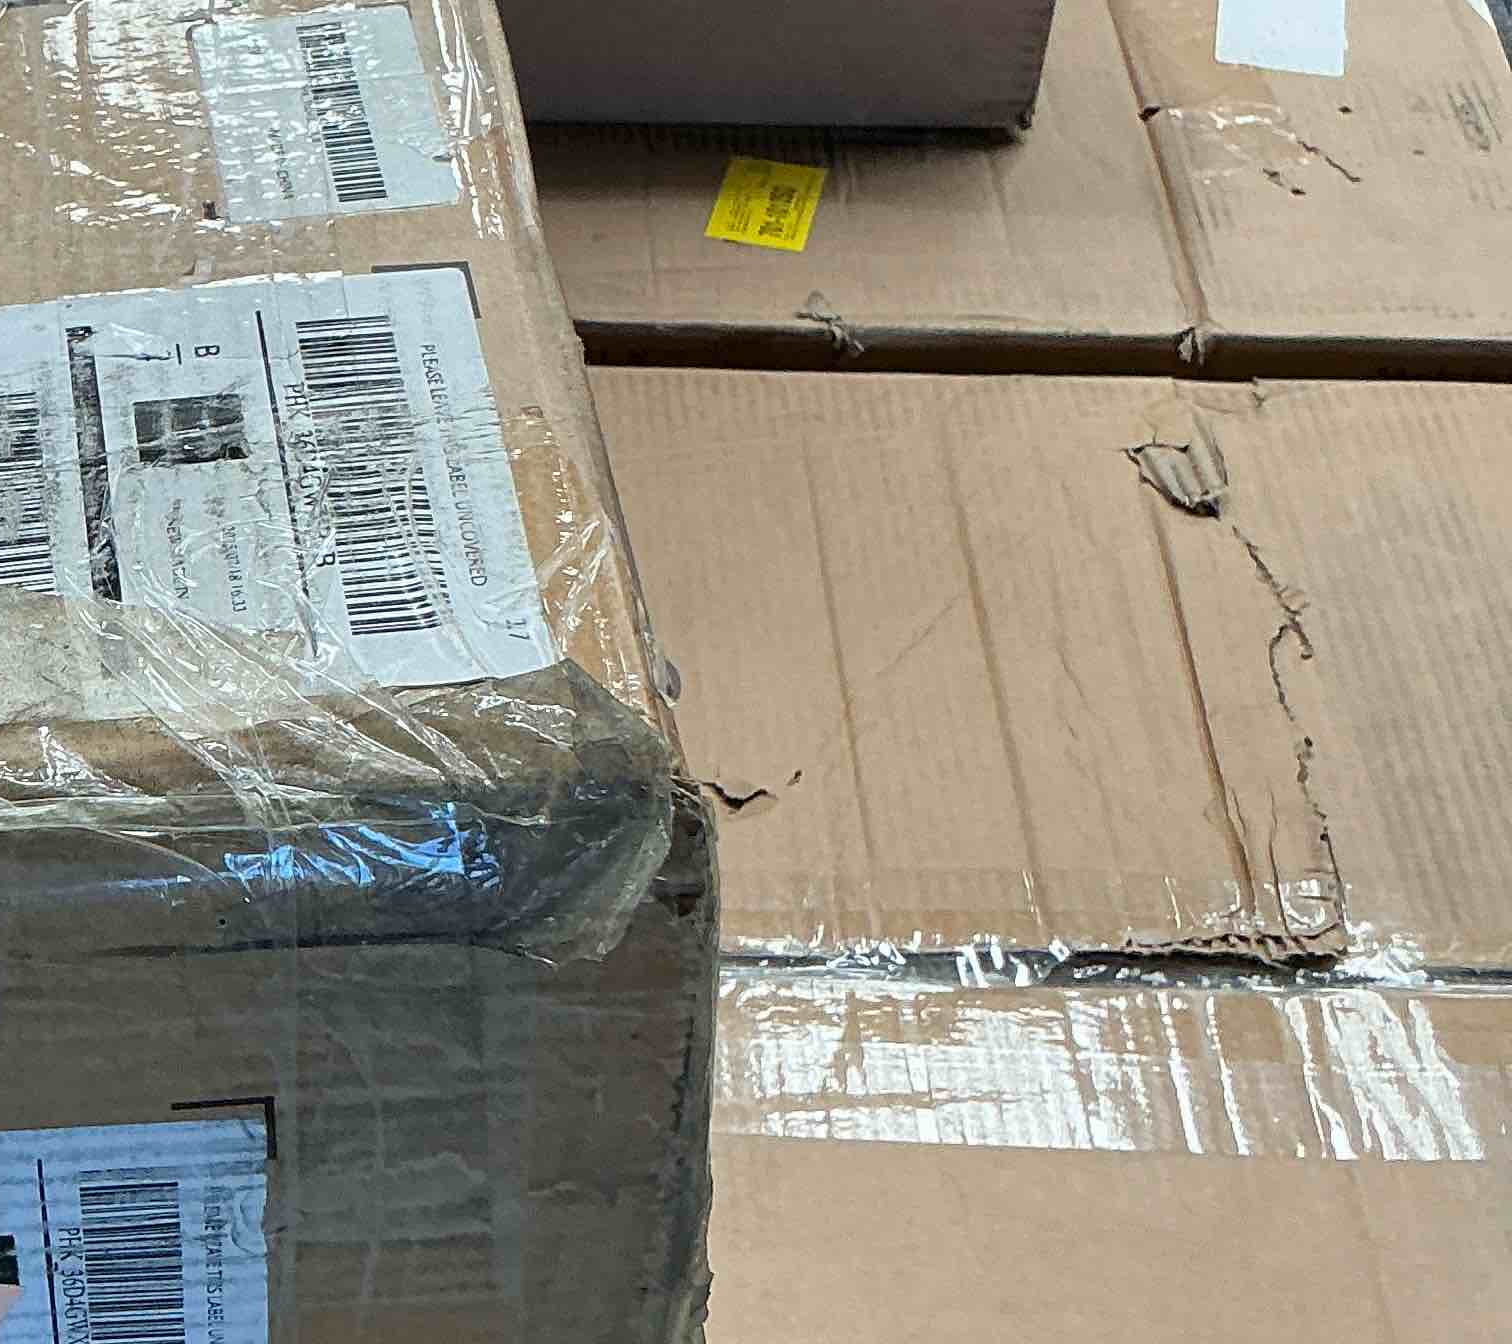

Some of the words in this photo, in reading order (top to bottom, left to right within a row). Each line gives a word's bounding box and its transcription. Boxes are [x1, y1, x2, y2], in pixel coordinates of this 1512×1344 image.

[194, 345, 221, 359] B
[420, 343, 440, 385] PLEASE
[454, 500, 487, 587] UNCOVERED
